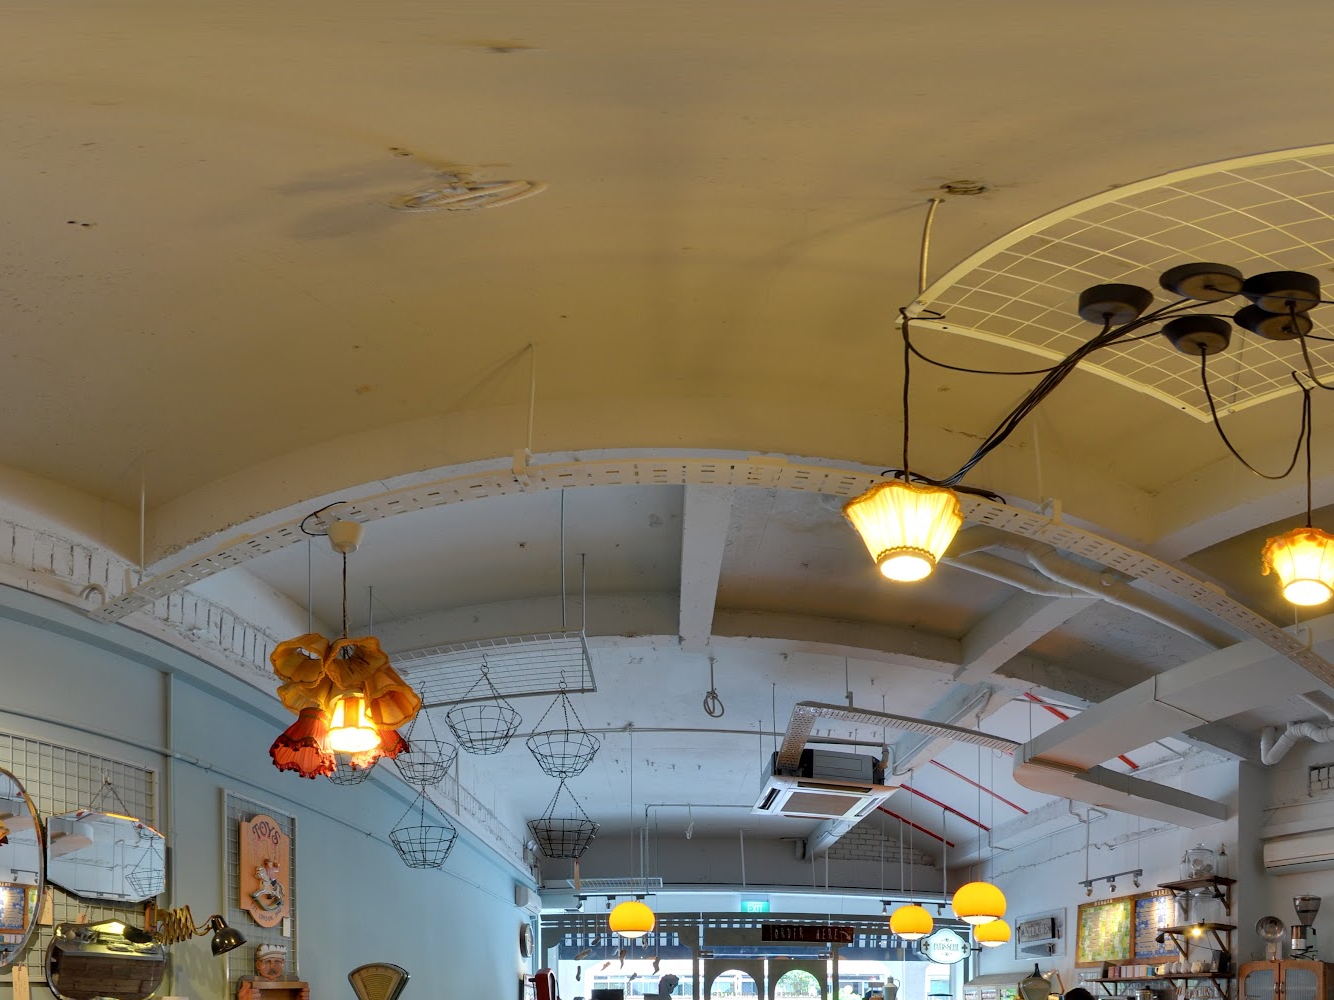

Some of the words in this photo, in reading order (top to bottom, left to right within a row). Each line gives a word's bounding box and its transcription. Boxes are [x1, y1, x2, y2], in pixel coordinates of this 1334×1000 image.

[252, 822, 280, 844] TOYS
[747, 904, 763, 912] EXIT
[774, 928, 804, 939] ORDER
